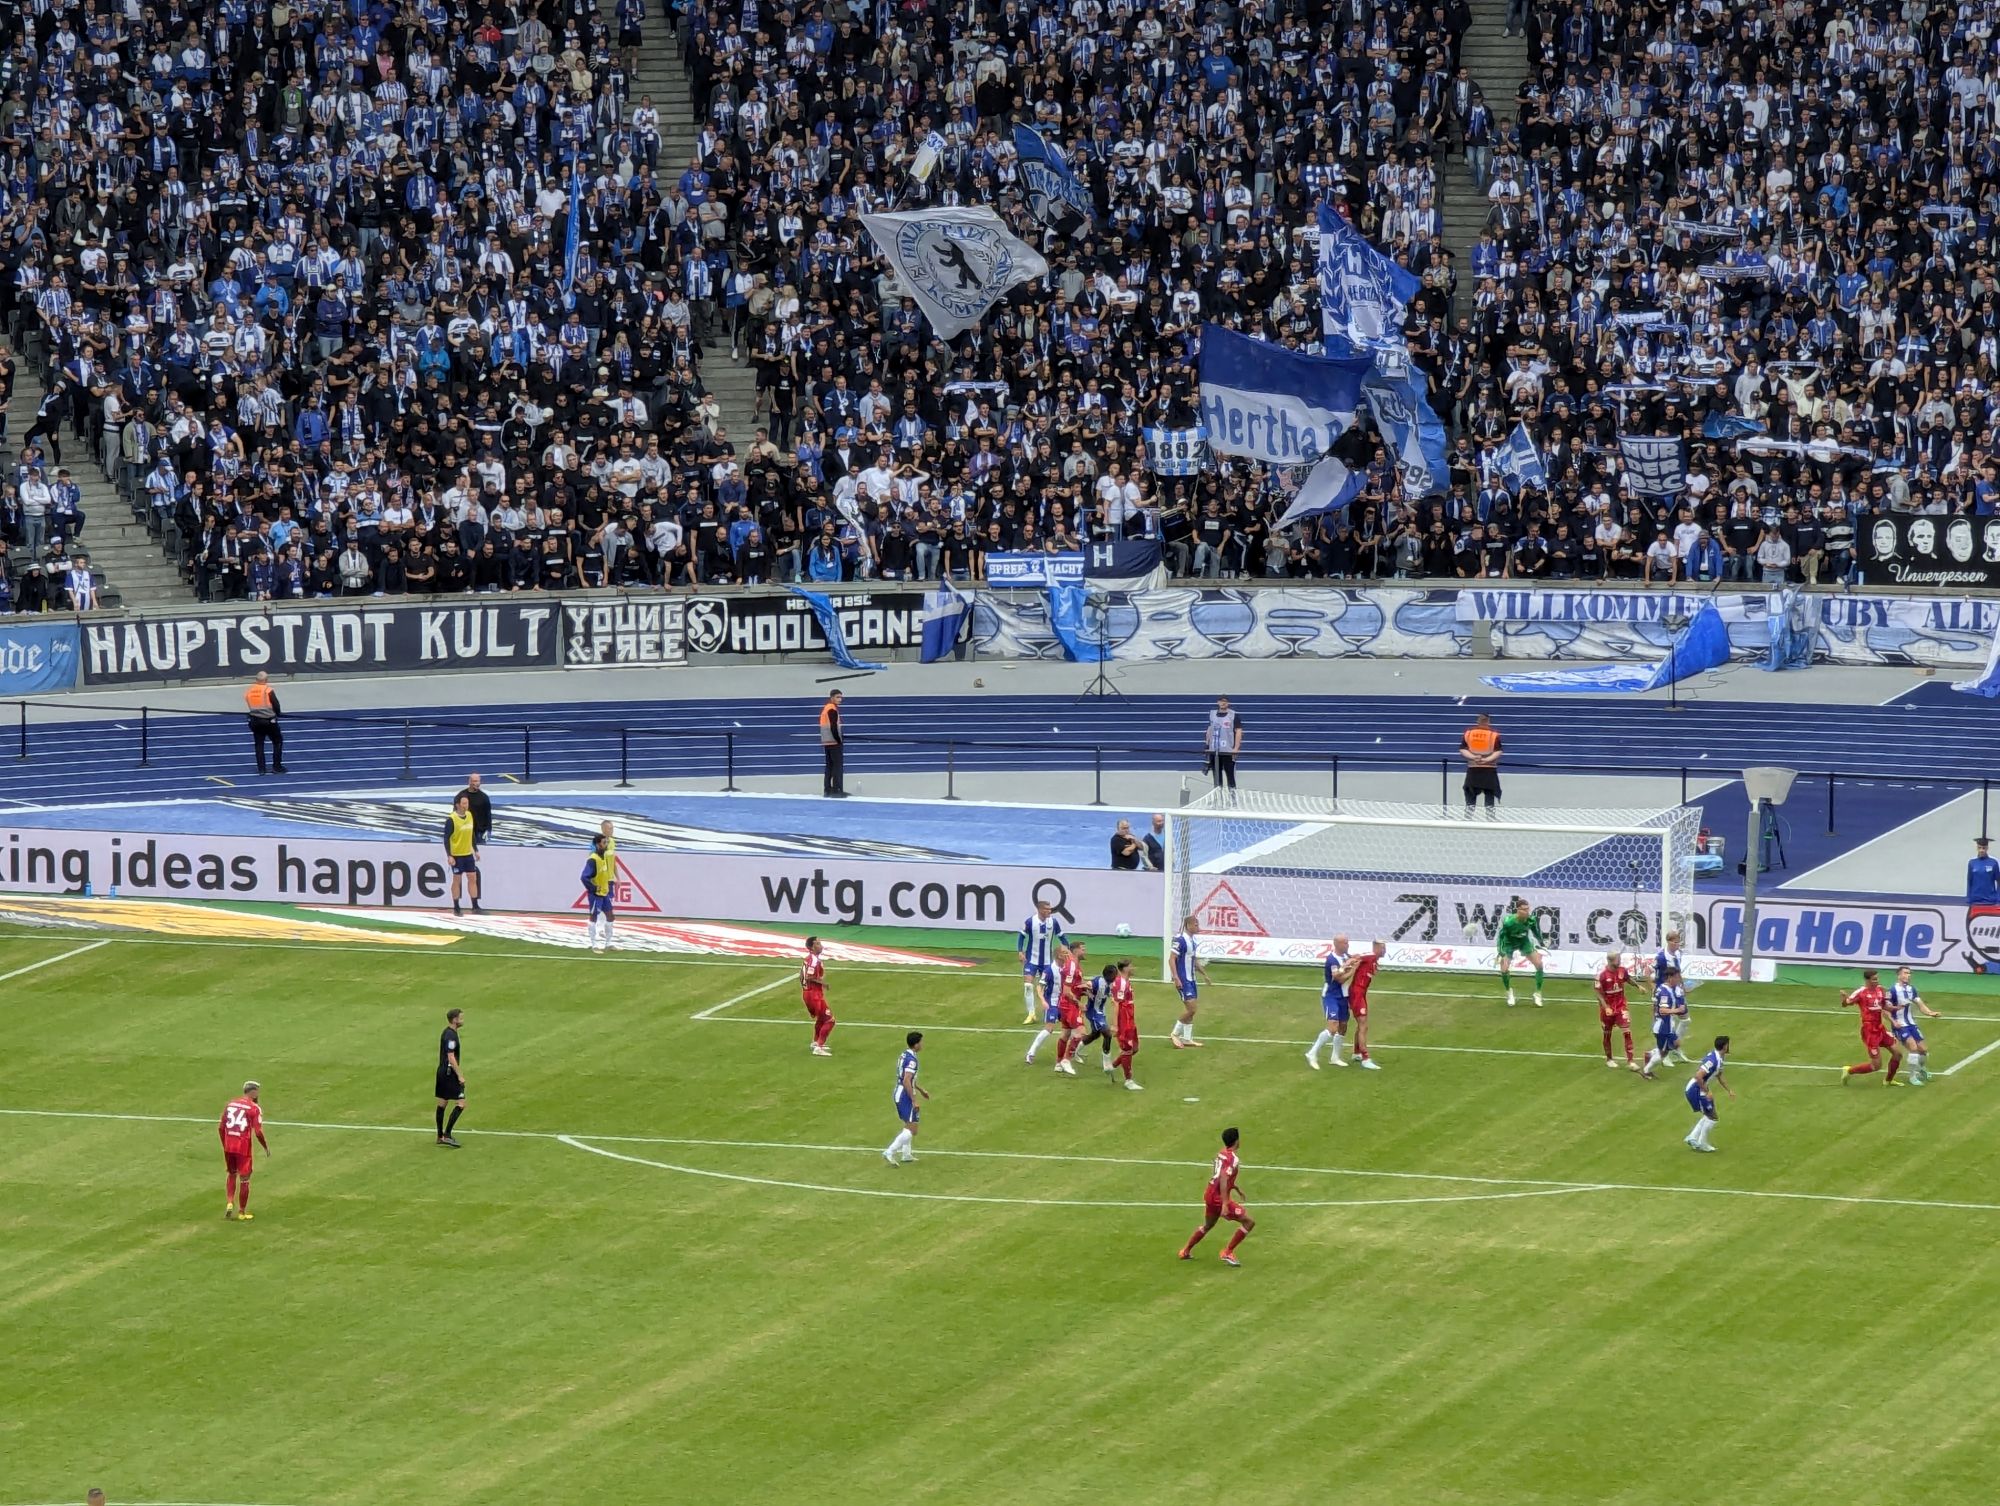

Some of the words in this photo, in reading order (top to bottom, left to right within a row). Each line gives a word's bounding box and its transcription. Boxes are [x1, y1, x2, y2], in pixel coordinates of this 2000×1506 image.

[1202, 394, 1317, 465] Hertha
[1147, 440, 1206, 459] 1892
[1620, 441, 1679, 460] NUR
[1625, 457, 1681, 476] DER
[1628, 473, 1684, 491] BSC
[1093, 545, 1114, 568] H
[1888, 563, 1988, 587] Unvergessen
[844, 594, 872, 607] BSC
[1473, 591, 1703, 622] WILLKOMME
[1922, 601, 1998, 630] ALE
[87, 613, 394, 676] HAUPTSTADT
[420, 607, 550, 661] KULT
[731, 609, 925, 650] HOOLGANS
[0, 833, 89, 895] ing
[112, 838, 258, 891] ideas
[278, 844, 482, 906] happe
[761, 869, 1005, 926] wtg.com
[1454, 895, 1707, 951] wg.com
[1226, 940, 1256, 956] 24
[1425, 949, 1453, 965] 24
[226, 1106, 248, 1132] 34
